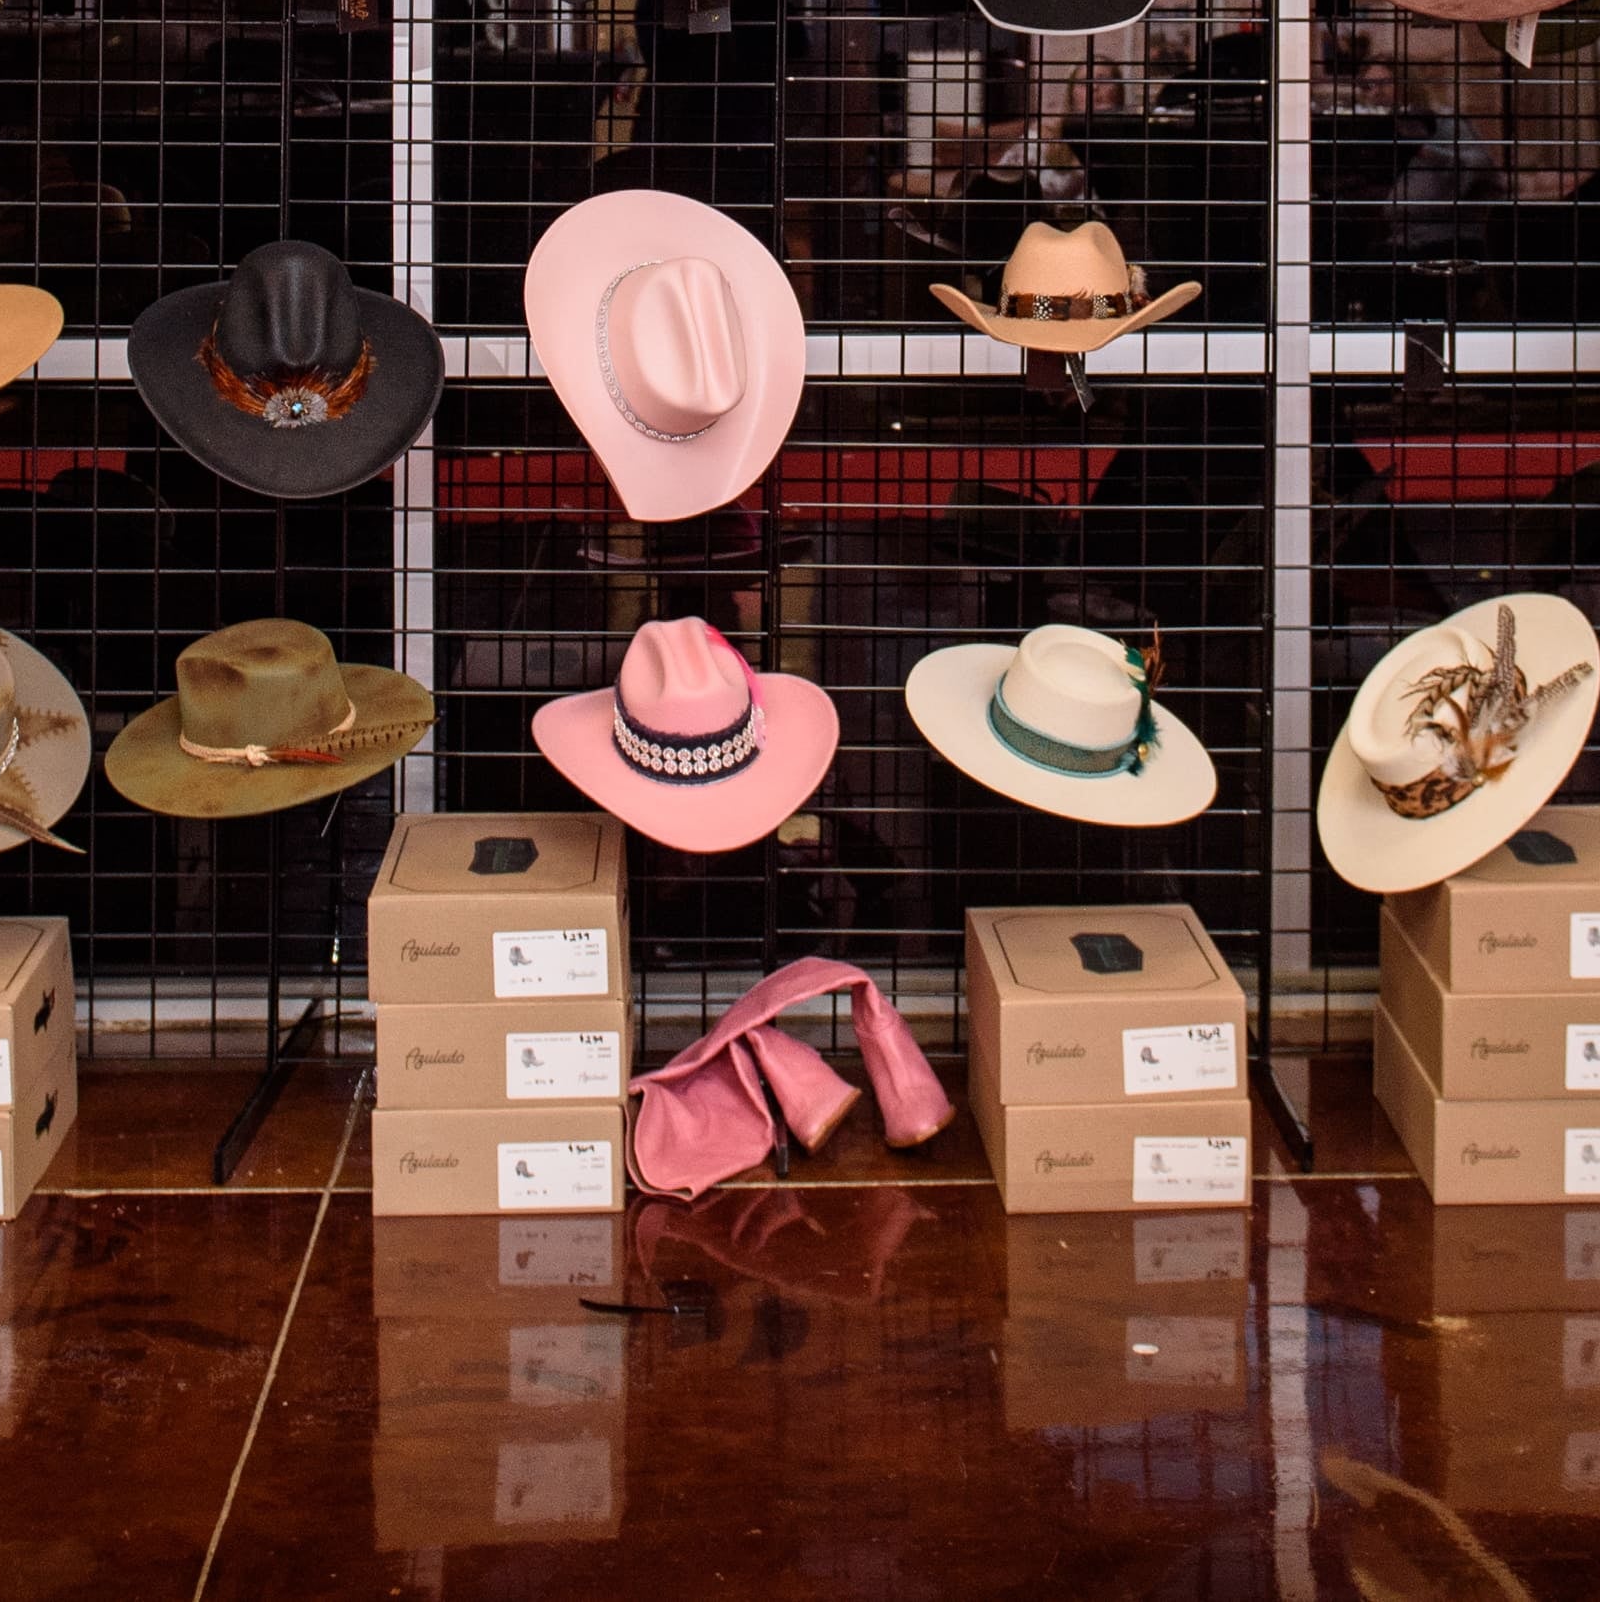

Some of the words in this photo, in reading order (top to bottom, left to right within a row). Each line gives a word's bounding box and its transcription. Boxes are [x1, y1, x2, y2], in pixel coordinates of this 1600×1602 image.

[400, 938, 460, 962] Azulado
[404, 1047, 465, 1070] Azulado
[1026, 1041, 1087, 1065] Azulado
[399, 1151, 460, 1174] Azulado
